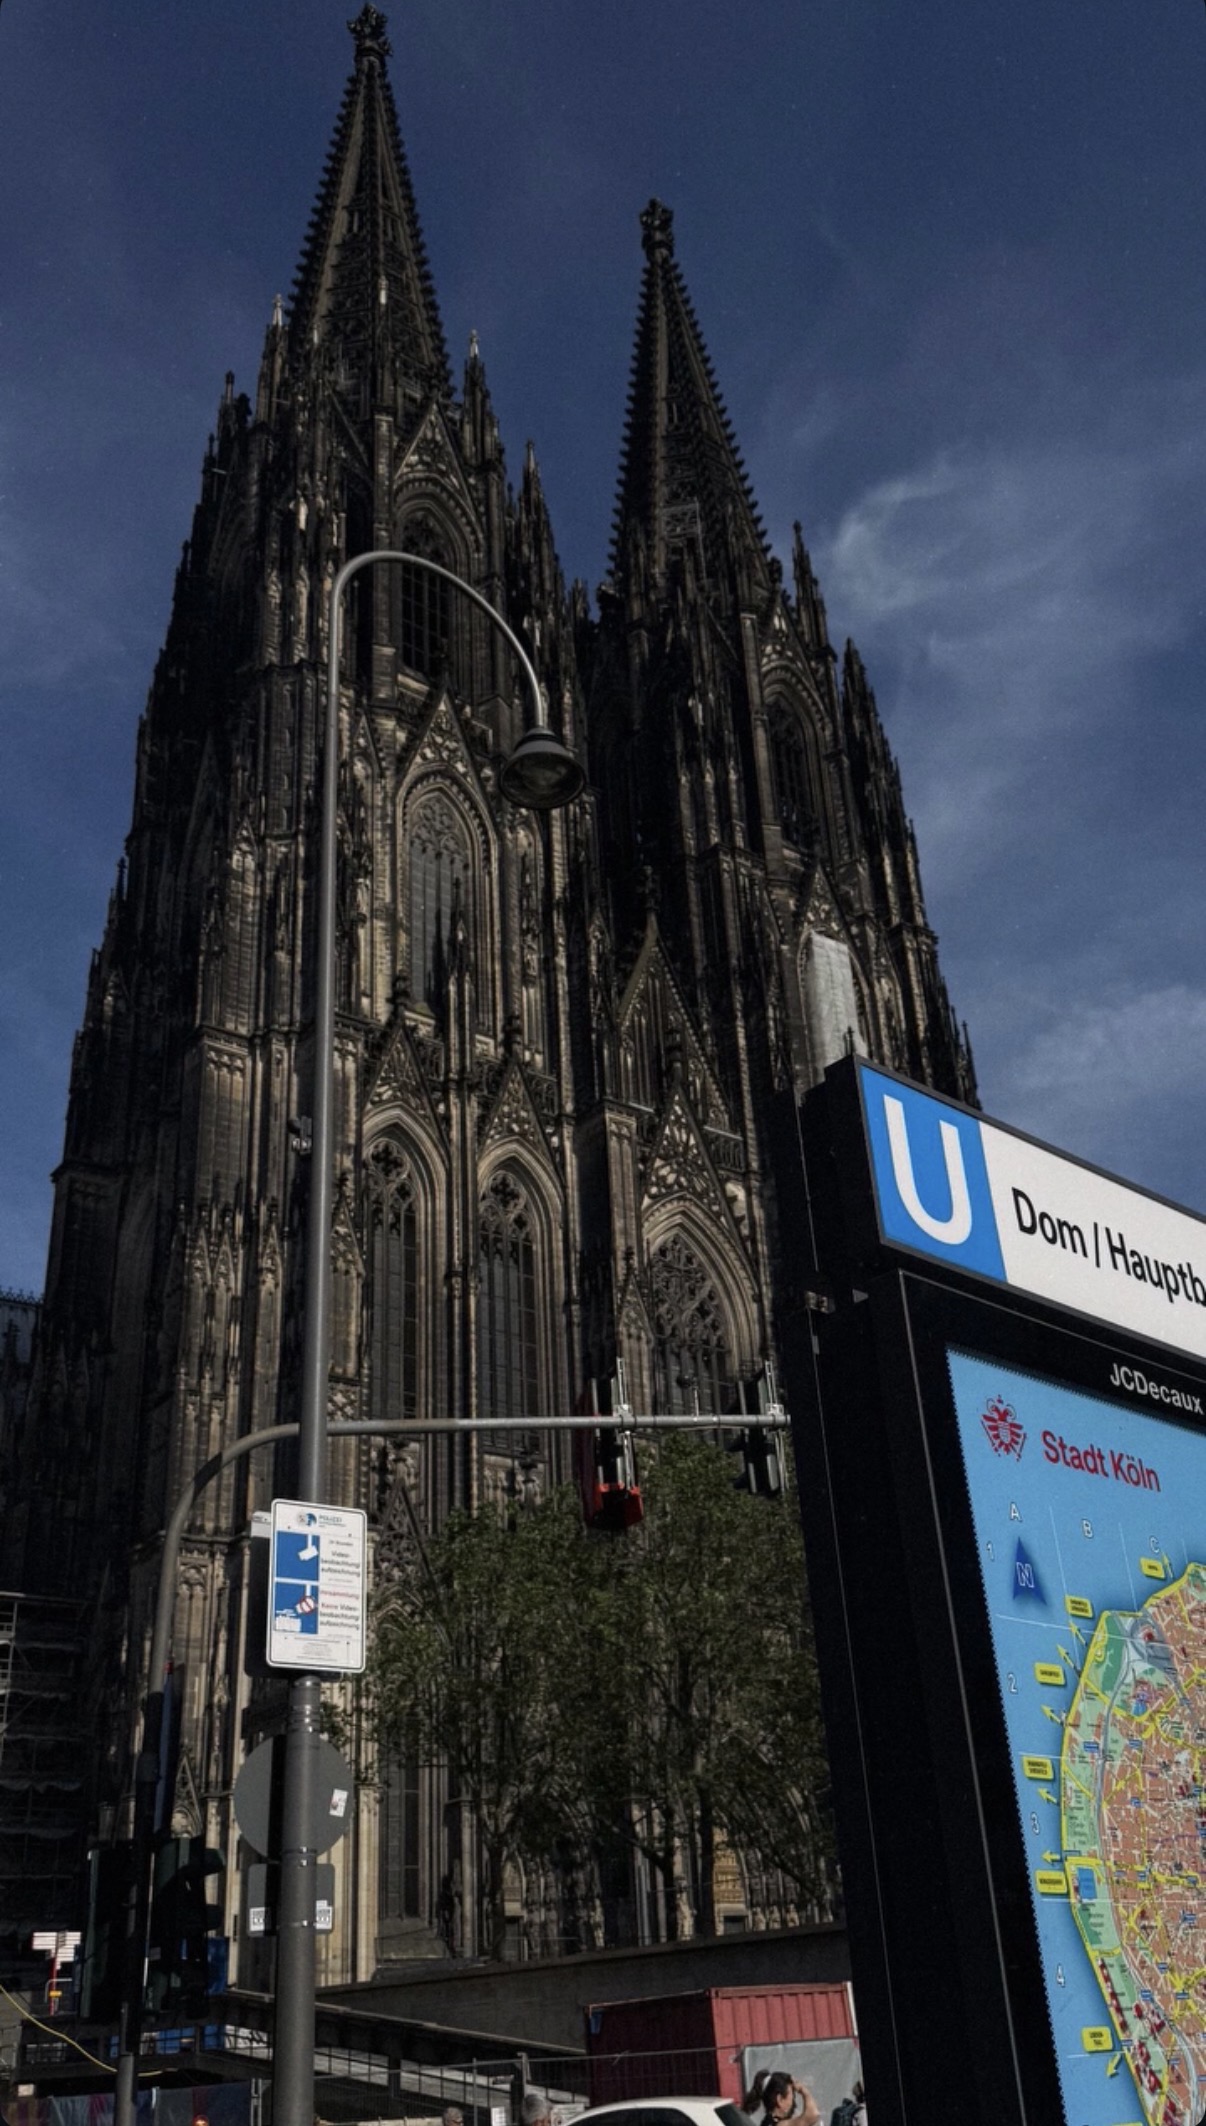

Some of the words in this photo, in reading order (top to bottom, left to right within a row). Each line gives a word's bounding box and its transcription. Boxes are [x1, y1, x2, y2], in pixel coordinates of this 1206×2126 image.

[884, 1095, 972, 1245] U
[1011, 1186, 1088, 1258] Dom
[1110, 1362, 1205, 1415] JCDecaux
[1041, 1430, 1109, 1478] Stadt
[1109, 1449, 1161, 1492] Köln
[1010, 1502, 1022, 1522] A
[1081, 1519, 1093, 1538] B
[986, 1541, 994, 1559] 1
[1150, 1536, 1160, 1553] C
[1016, 1562, 1035, 1588] N
[1007, 1673, 1018, 1693] 2
[1030, 1812, 1040, 1834] 3
[1056, 1963, 1065, 1988] 4
